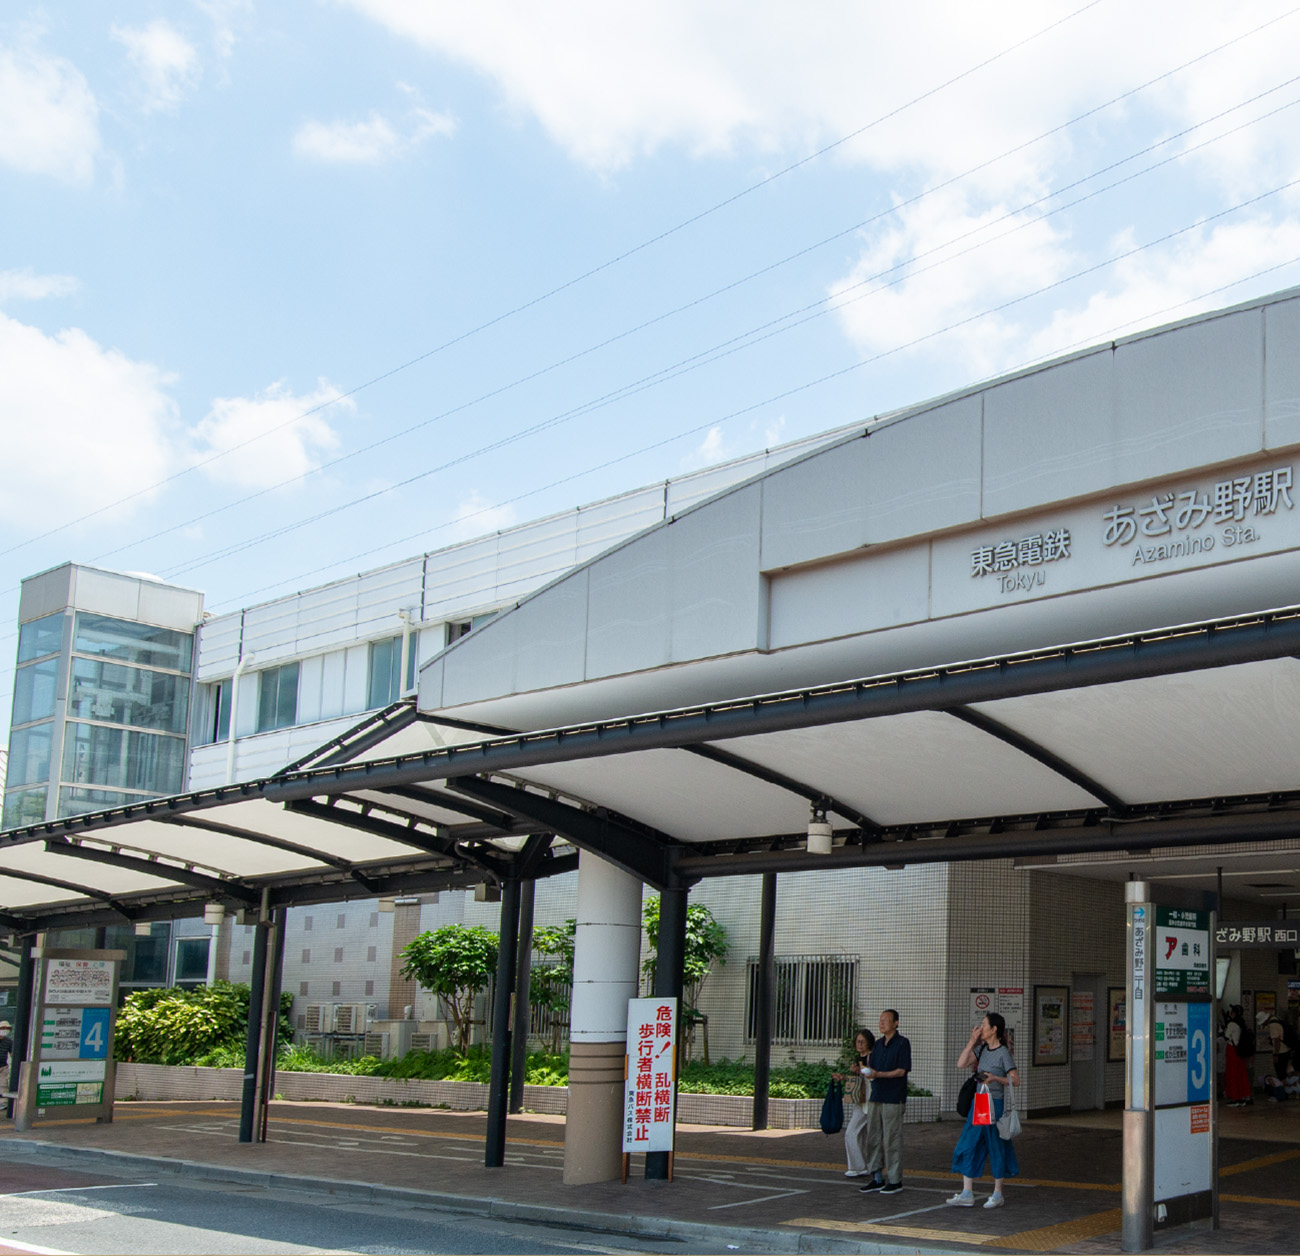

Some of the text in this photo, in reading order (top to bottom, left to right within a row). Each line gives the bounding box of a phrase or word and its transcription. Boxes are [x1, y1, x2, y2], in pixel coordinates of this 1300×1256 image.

[1102, 466, 1294, 546] あざみ野駅
[970, 528, 1071, 577] 東急電鉄
[1131, 525, 1261, 566] Azamino Sta.
[997, 568, 1046, 593] Tokyu
[1274, 929, 1298, 942] 西口
[85, 1022, 103, 1052] 4
[655, 1005, 673, 1059] 危険！
[634, 1023, 655, 1142] 歩行者横断禁止
[1191, 1029, 1206, 1089] 3
[626, 1090, 635, 1144] 東急バス株式会社
[654, 1072, 671, 1123] 乱横断
